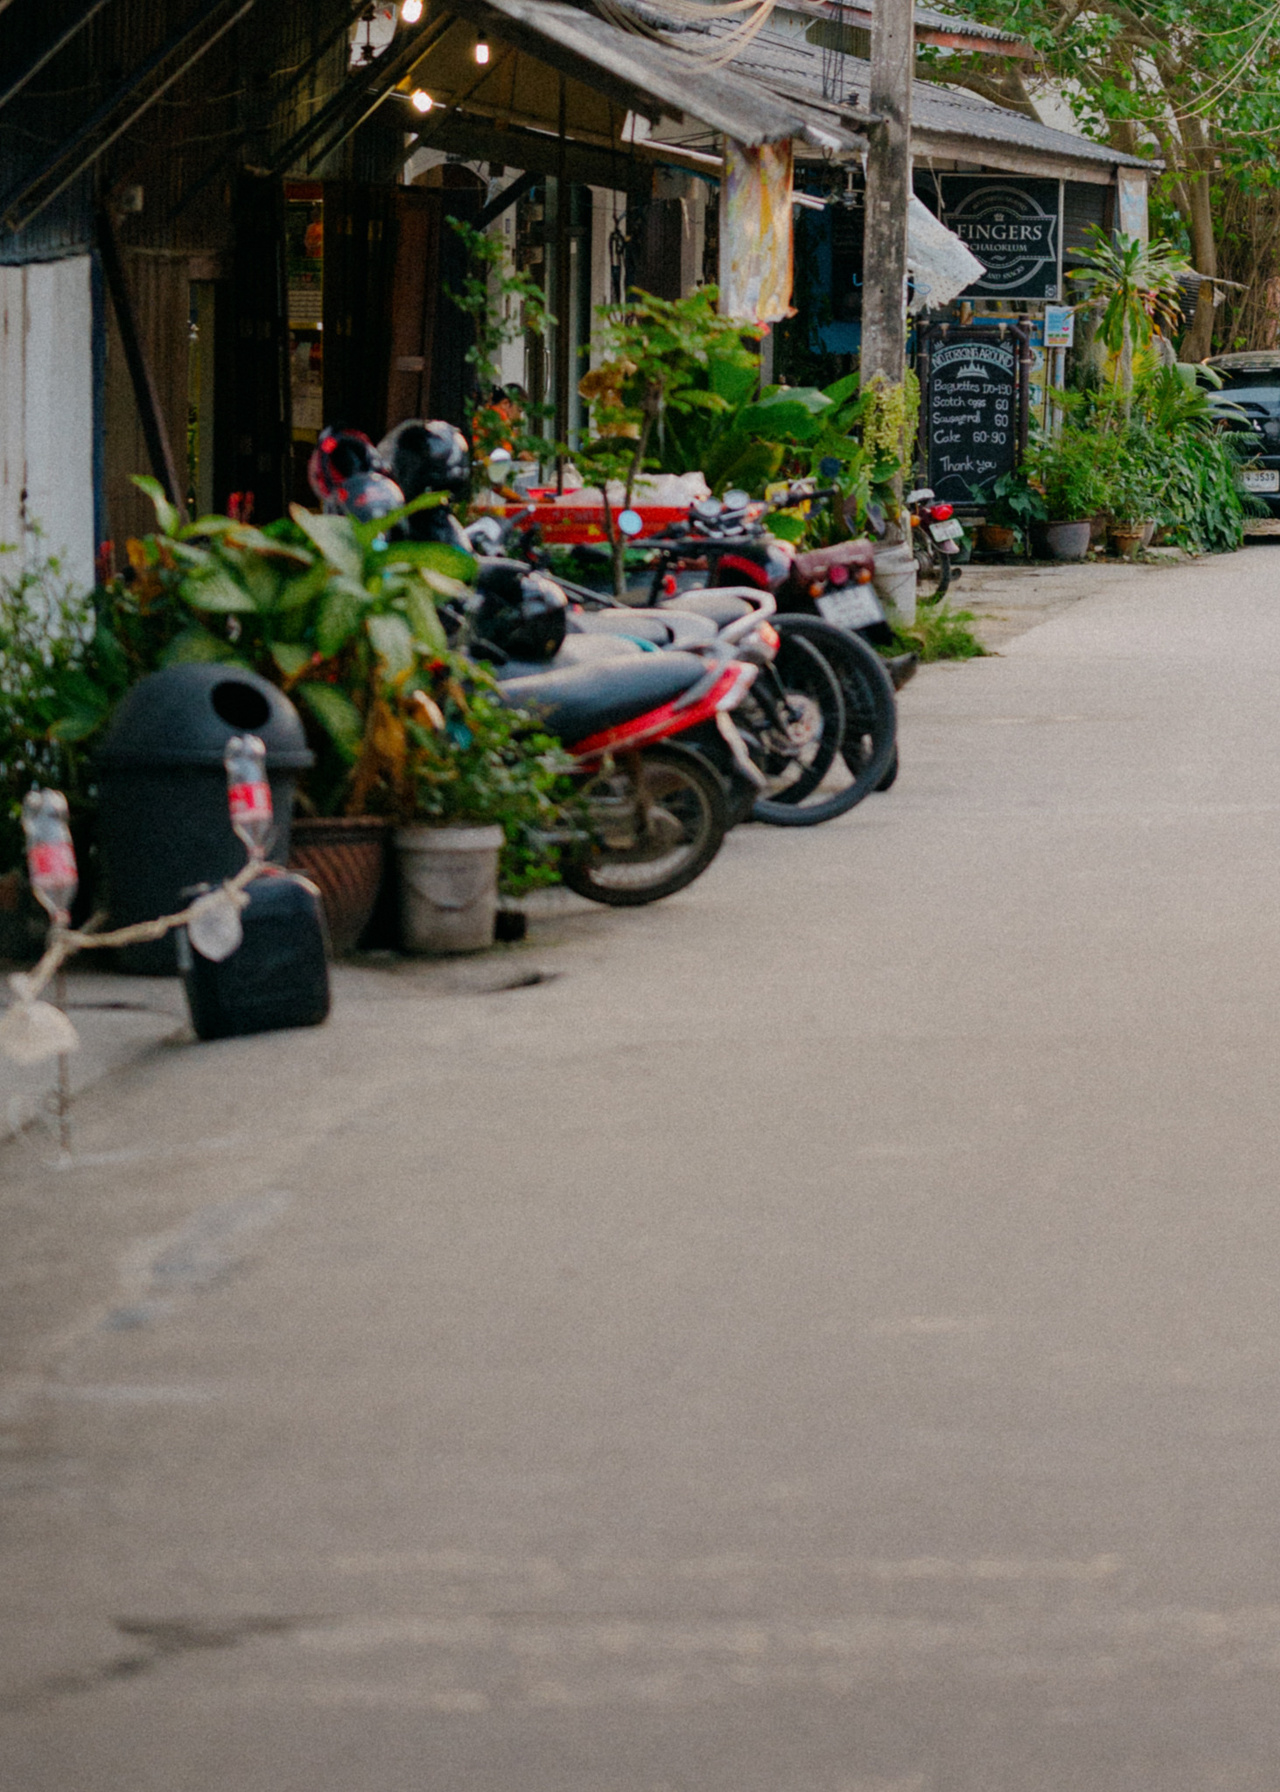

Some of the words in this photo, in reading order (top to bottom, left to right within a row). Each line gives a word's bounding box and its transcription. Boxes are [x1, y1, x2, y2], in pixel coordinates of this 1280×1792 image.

[956, 223, 1042, 241] FINGERS
[970, 243, 1028, 252] CHALOKLUM
[934, 379, 980, 395] Baguettes
[933, 396, 965, 407] Scotch
[995, 399, 1009, 411] 60
[994, 413, 1009, 427] 60
[933, 429, 962, 444] Cake
[939, 455, 975, 472] Thank
[976, 460, 997, 474] you
